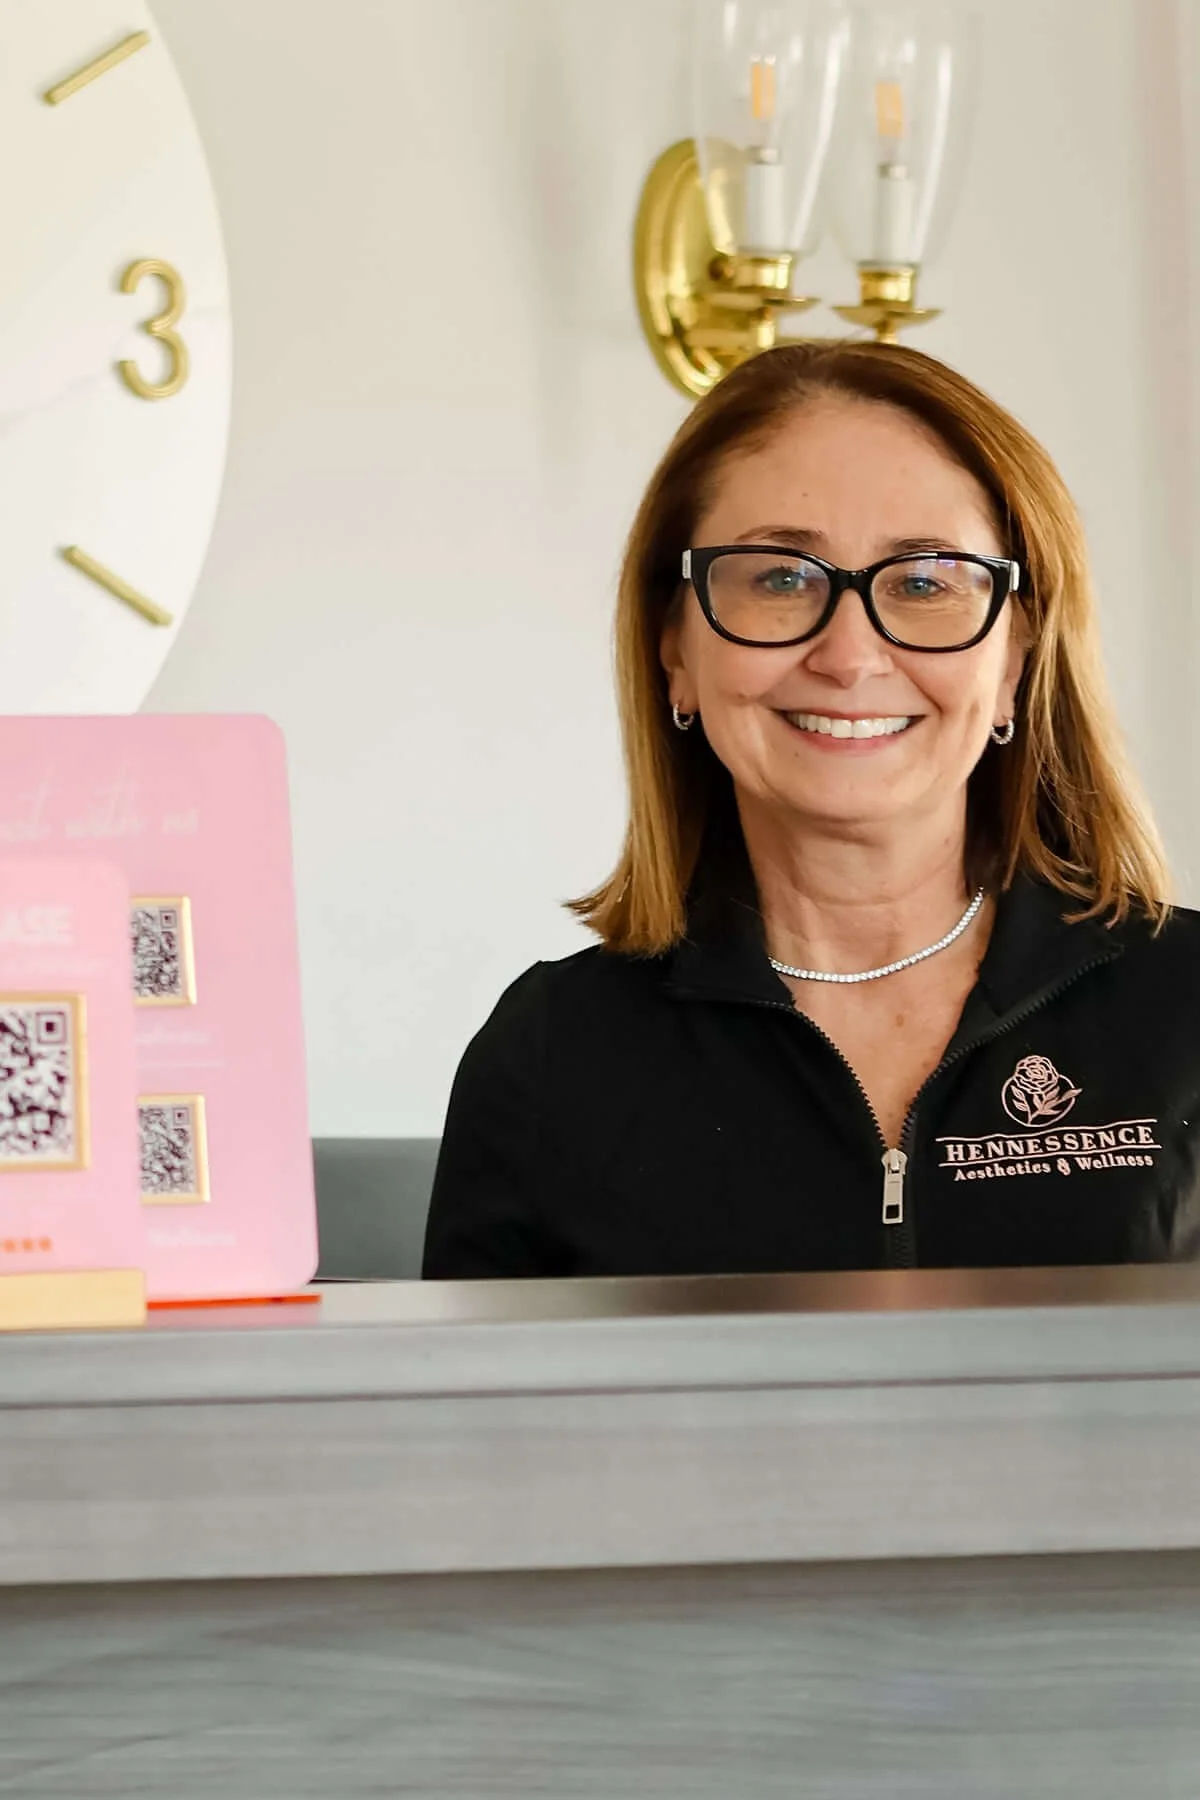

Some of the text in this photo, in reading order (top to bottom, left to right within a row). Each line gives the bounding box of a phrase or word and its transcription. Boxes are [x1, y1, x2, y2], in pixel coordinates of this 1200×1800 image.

[116, 259, 188, 400] 3
[945, 1125, 1155, 1162] HENNESSENCE
[954, 1152, 1154, 1181] Aesthetics & Wellness
